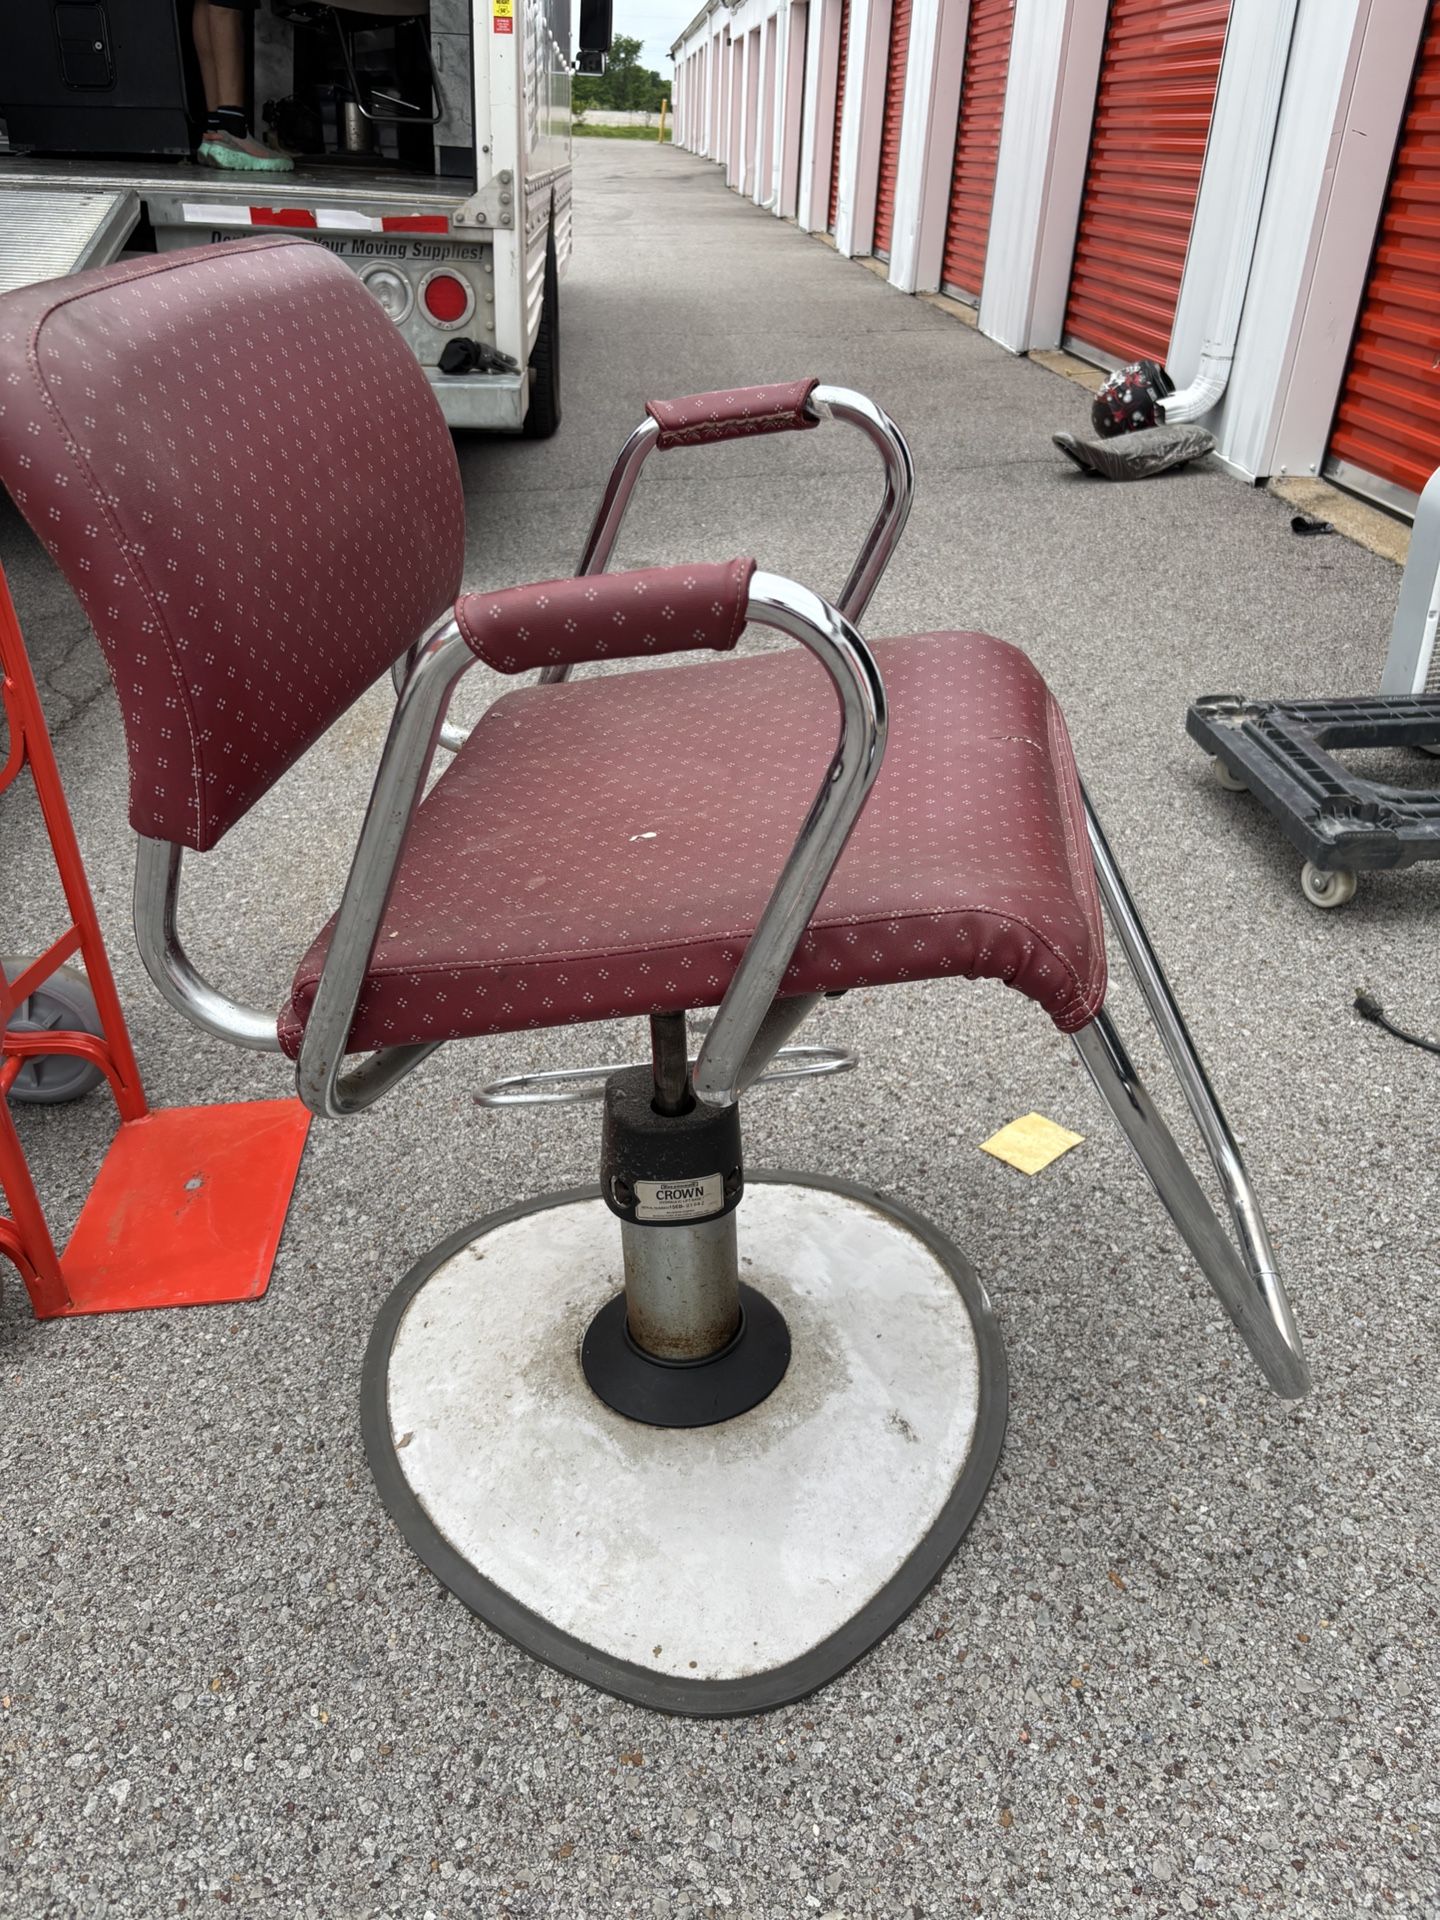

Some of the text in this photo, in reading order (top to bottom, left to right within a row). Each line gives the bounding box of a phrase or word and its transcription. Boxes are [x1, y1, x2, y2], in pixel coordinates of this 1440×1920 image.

[351, 239, 407, 259] Moving
[412, 241, 484, 261] Supplies!
[656, 1186, 704, 1200] CROWN
